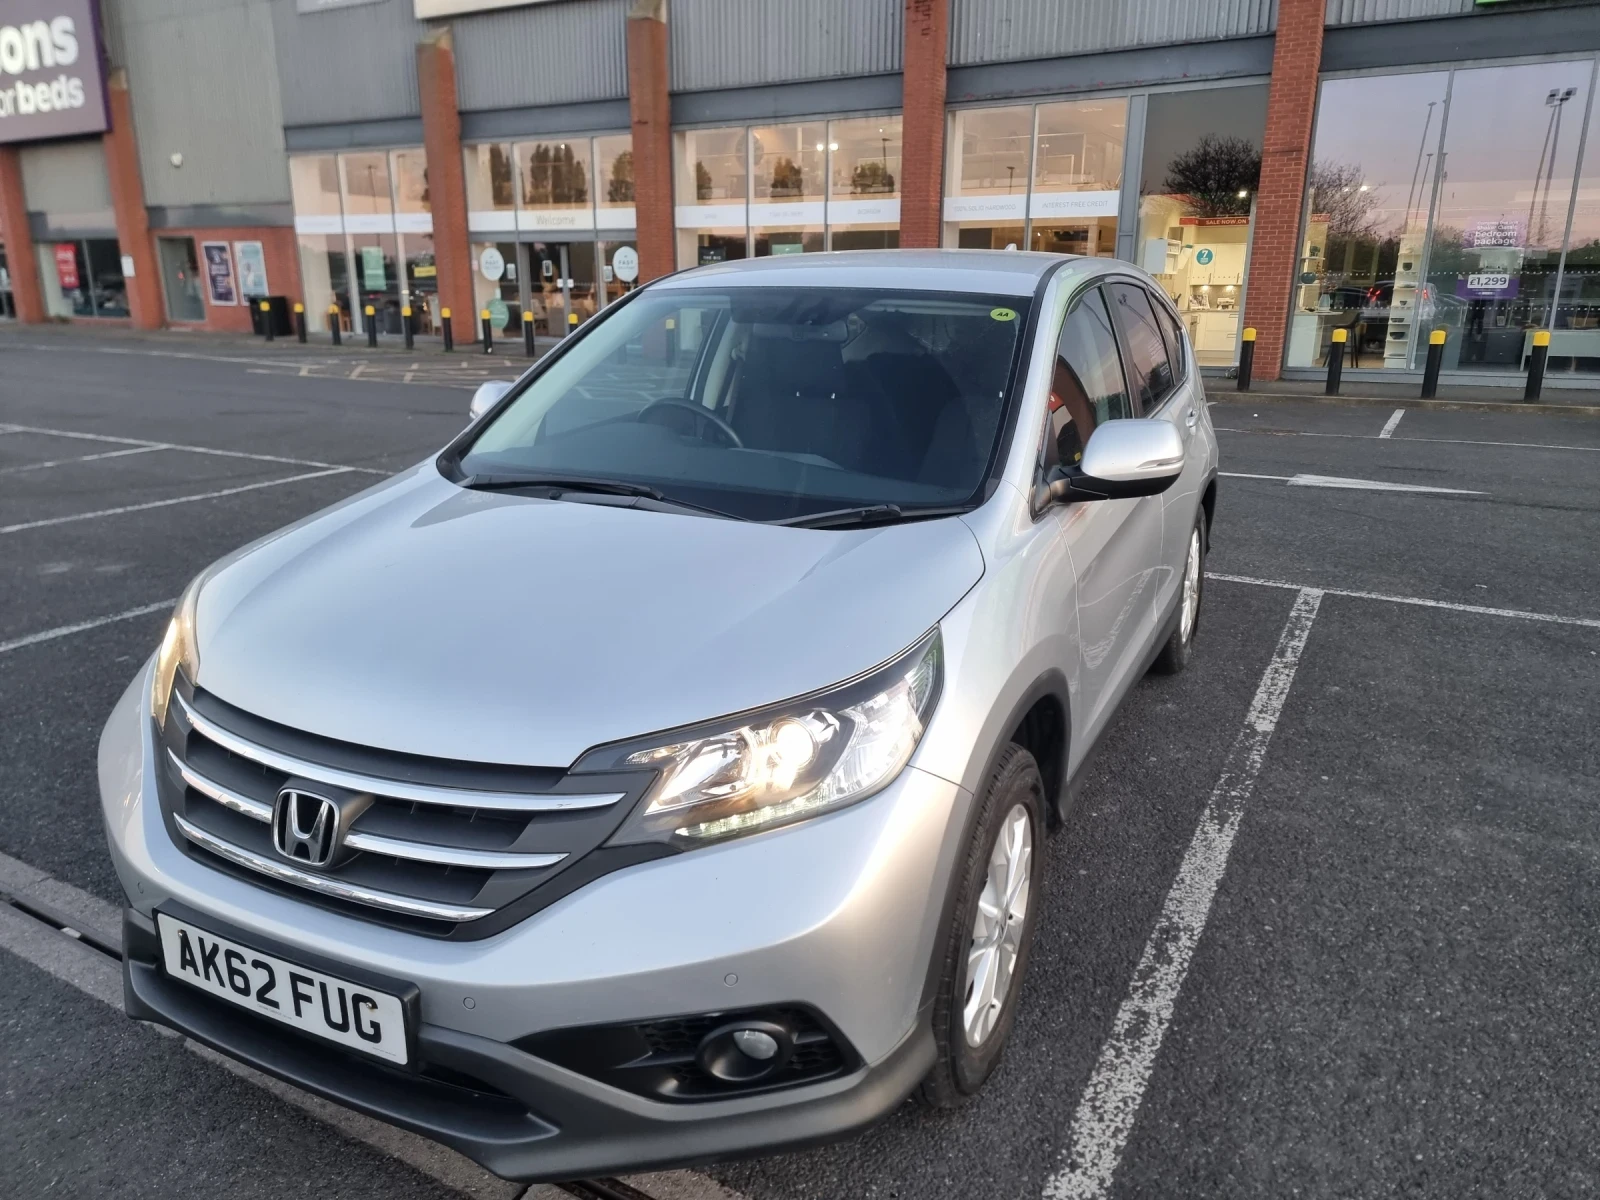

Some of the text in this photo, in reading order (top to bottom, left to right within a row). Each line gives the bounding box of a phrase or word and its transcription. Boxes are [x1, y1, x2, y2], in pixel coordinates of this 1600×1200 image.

[0, 15, 79, 75] ons
[1041, 201, 1070, 209] INTEREST
[1070, 200, 1086, 208] FREE
[535, 213, 576, 226] Welcome
[1473, 237, 1516, 246] package
[1469, 276, 1507, 287] £1,299
[179, 929, 382, 1044] AK62 FUG
